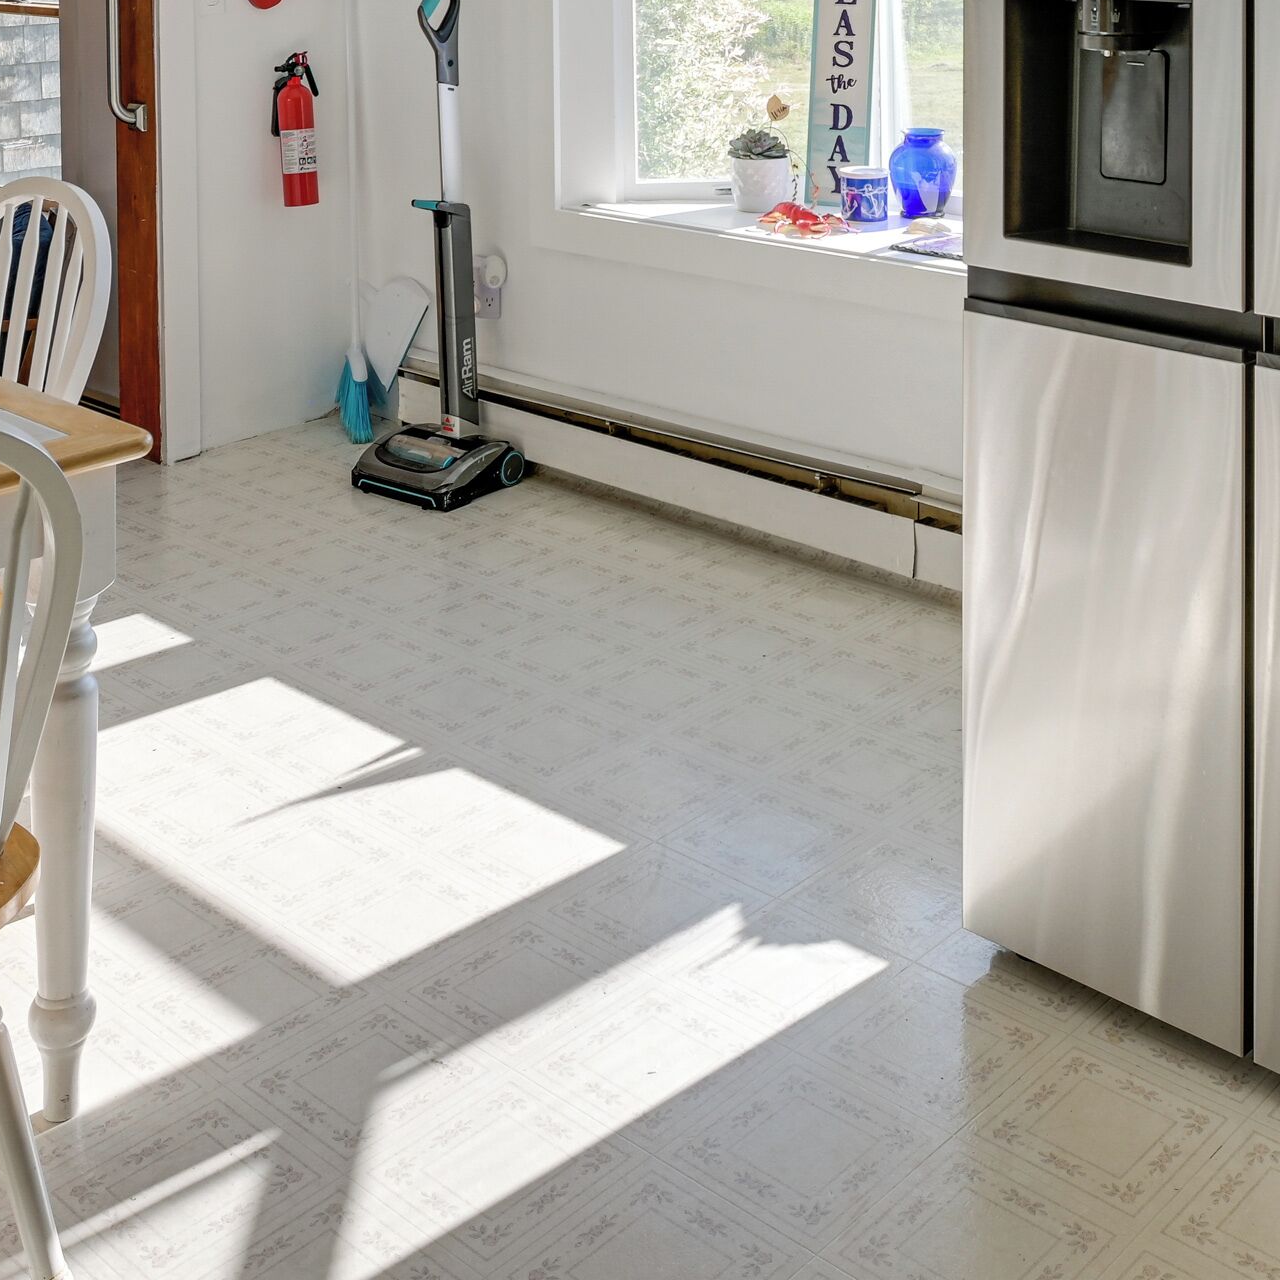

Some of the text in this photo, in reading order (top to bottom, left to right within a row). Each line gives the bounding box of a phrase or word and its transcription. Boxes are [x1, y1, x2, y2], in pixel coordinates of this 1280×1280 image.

[825, 73, 858, 95] the
[826, 102, 854, 195] DAY
[461, 337, 474, 400] AirRam
